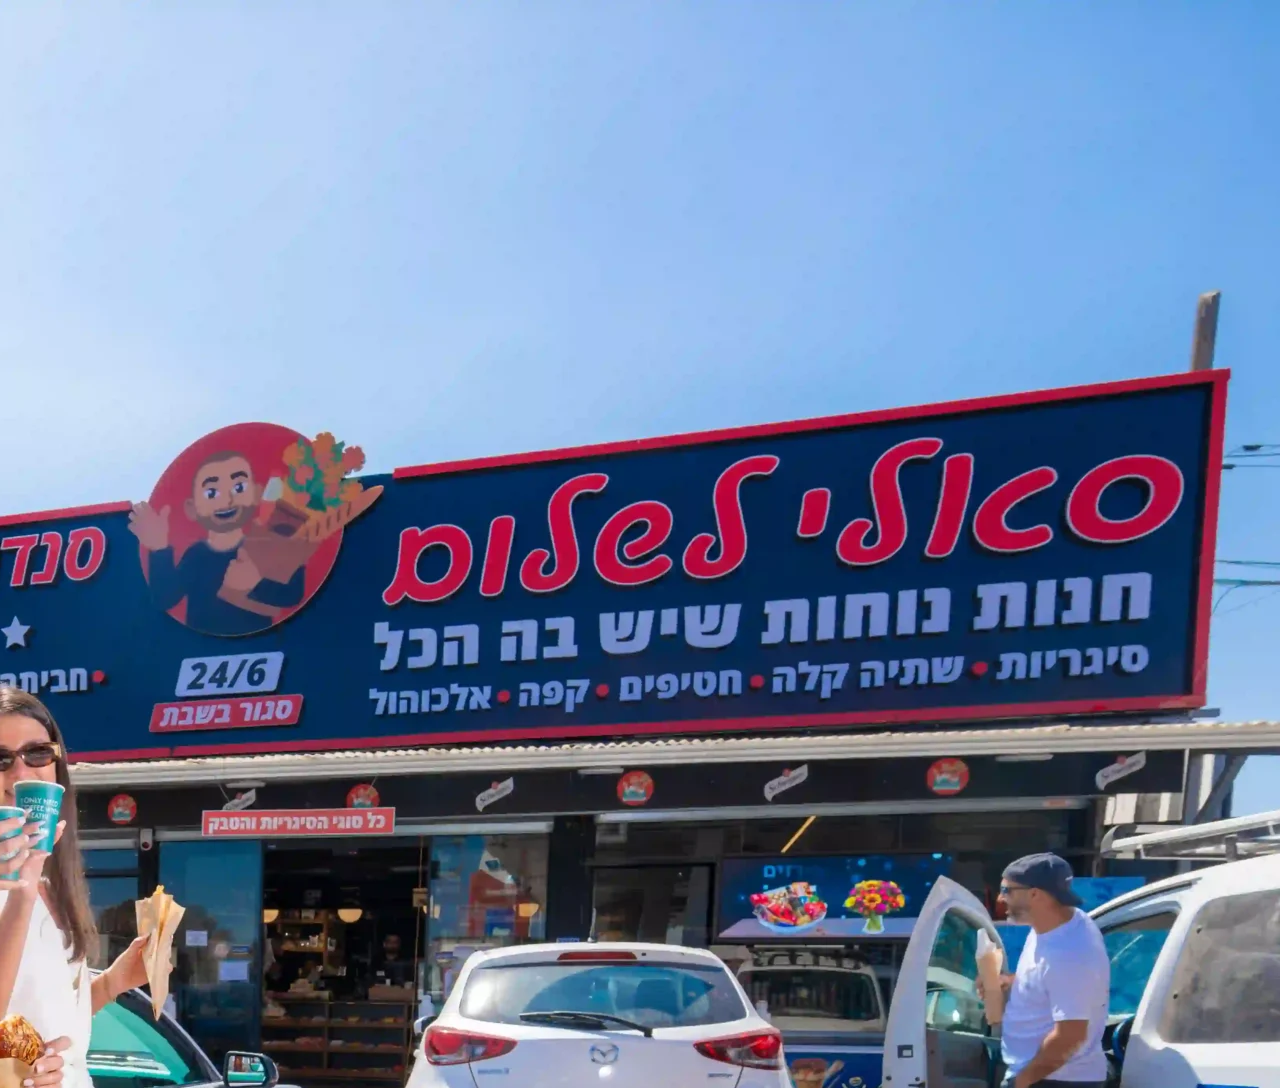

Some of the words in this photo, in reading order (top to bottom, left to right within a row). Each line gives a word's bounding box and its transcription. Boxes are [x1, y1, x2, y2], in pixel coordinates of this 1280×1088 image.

[382, 455, 780, 606] לשלום
[761, 587, 951, 645] נוחות
[973, 572, 1152, 631] חנות
[373, 621, 479, 671] הכל
[500, 616, 578, 662] בה
[599, 603, 742, 655] שיש
[187, 658, 268, 690] 24/6
[860, 655, 965, 689] שתיה
[996, 644, 1149, 680] סיגריות
[518, 678, 590, 713] קפה
[620, 669, 743, 702] חטיפים
[772, 660, 850, 699] קלה
[160, 704, 231, 726] בשבת
[240, 700, 293, 721] סגור
[369, 682, 492, 716] אלכוהול
[208, 816, 257, 834] והטבק
[259, 815, 329, 830] הסיגריות
[332, 815, 363, 829] סוגי
[367, 812, 386, 829] כל
